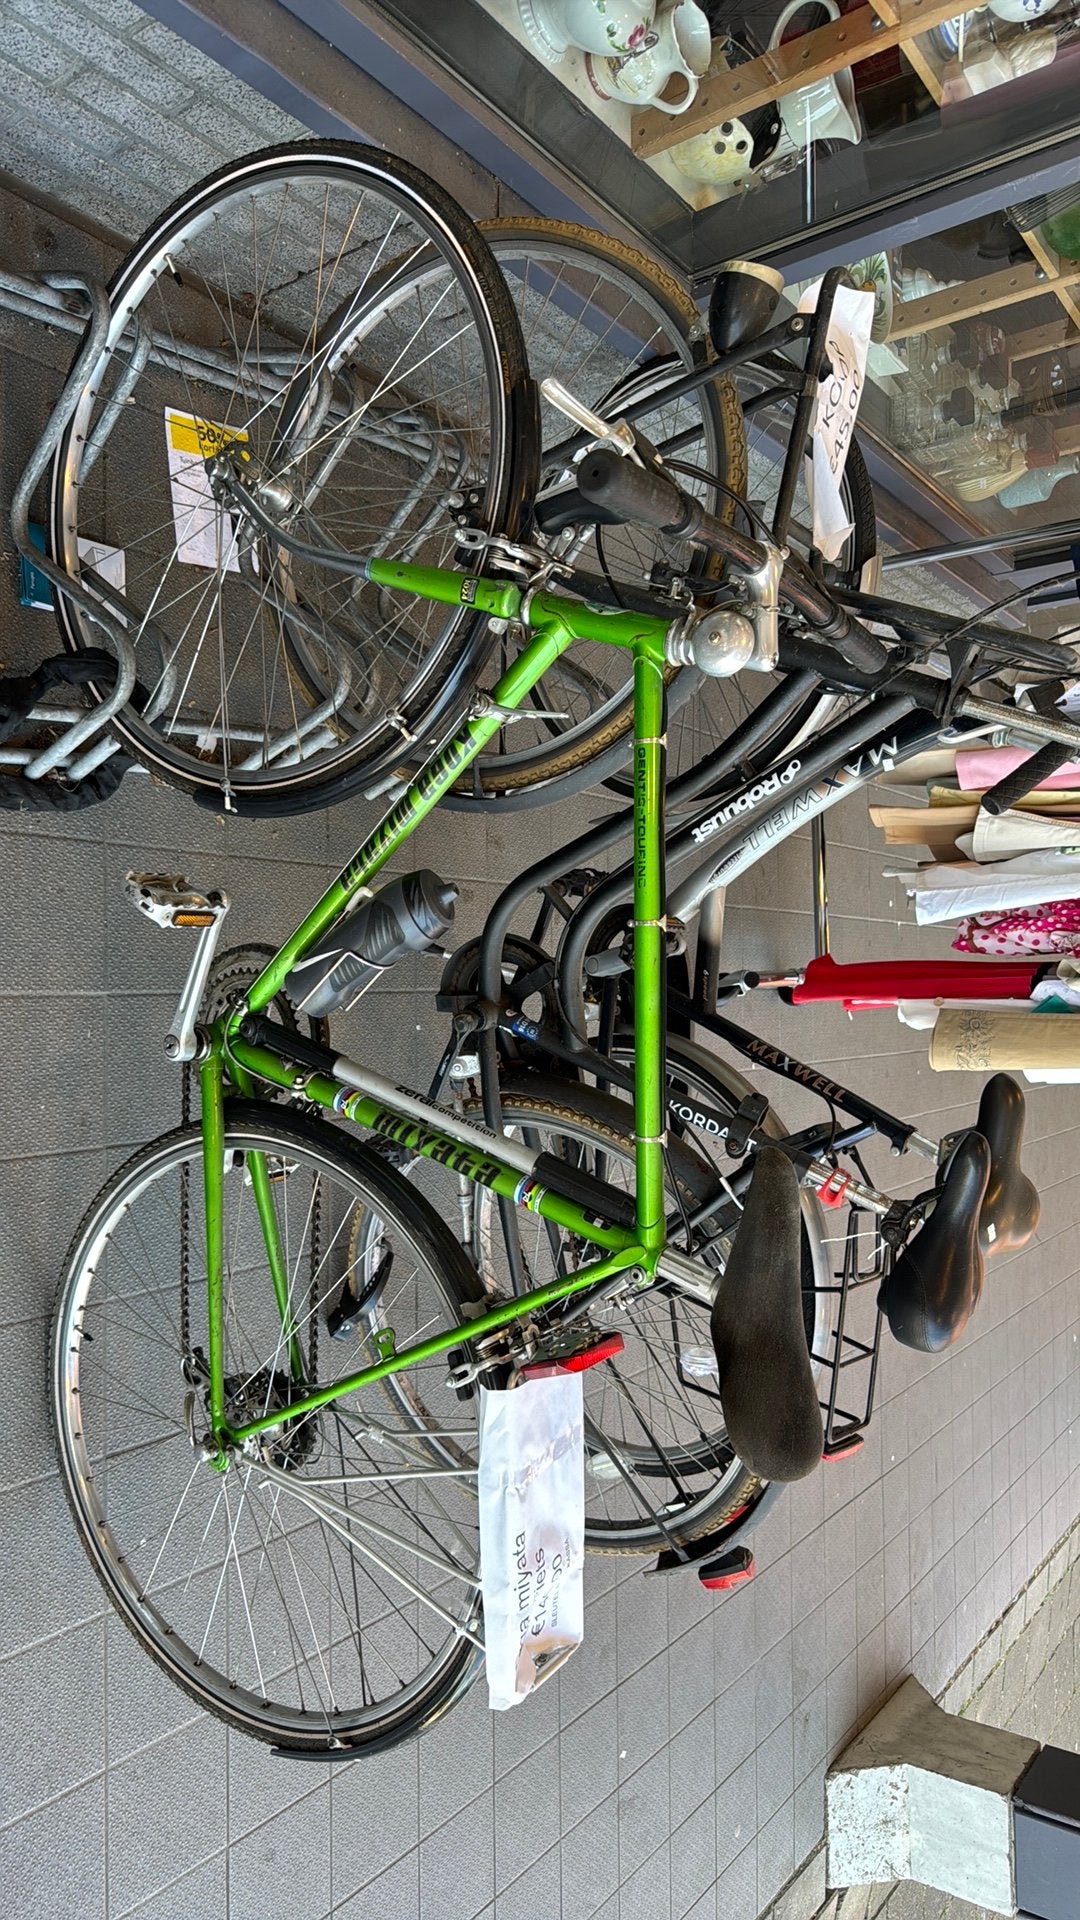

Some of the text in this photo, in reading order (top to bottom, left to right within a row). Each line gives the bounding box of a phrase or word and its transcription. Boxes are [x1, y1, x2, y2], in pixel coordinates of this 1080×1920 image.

[691, 772, 783, 844] Robuust
[743, 736, 898, 850] MAXWELL
[746, 1039, 847, 1102] MAXWELL
[371, 1108, 501, 1188] miyata
[512, 1531, 533, 1611] miyata
